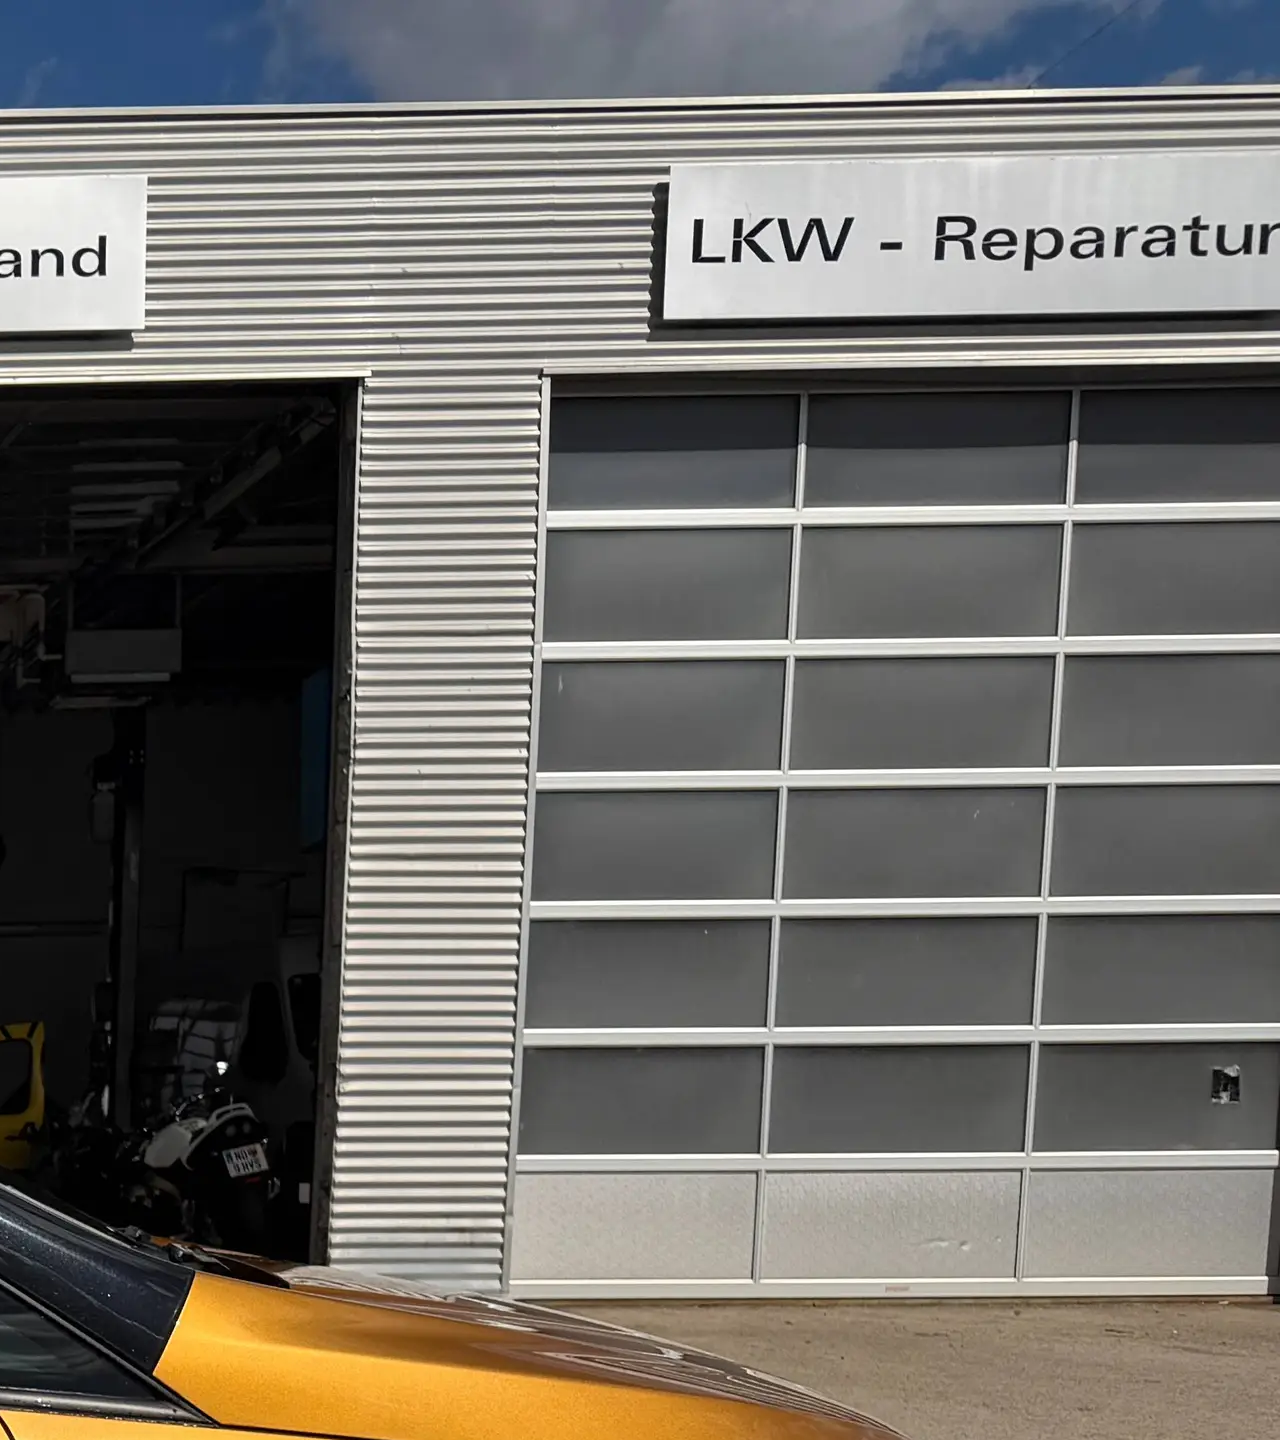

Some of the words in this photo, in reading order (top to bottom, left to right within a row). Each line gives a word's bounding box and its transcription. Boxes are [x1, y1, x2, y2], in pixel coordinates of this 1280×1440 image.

[691, 216, 855, 264] LKW
[880, 241, 903, 251] -
[934, 215, 1280, 272] Reparatur
